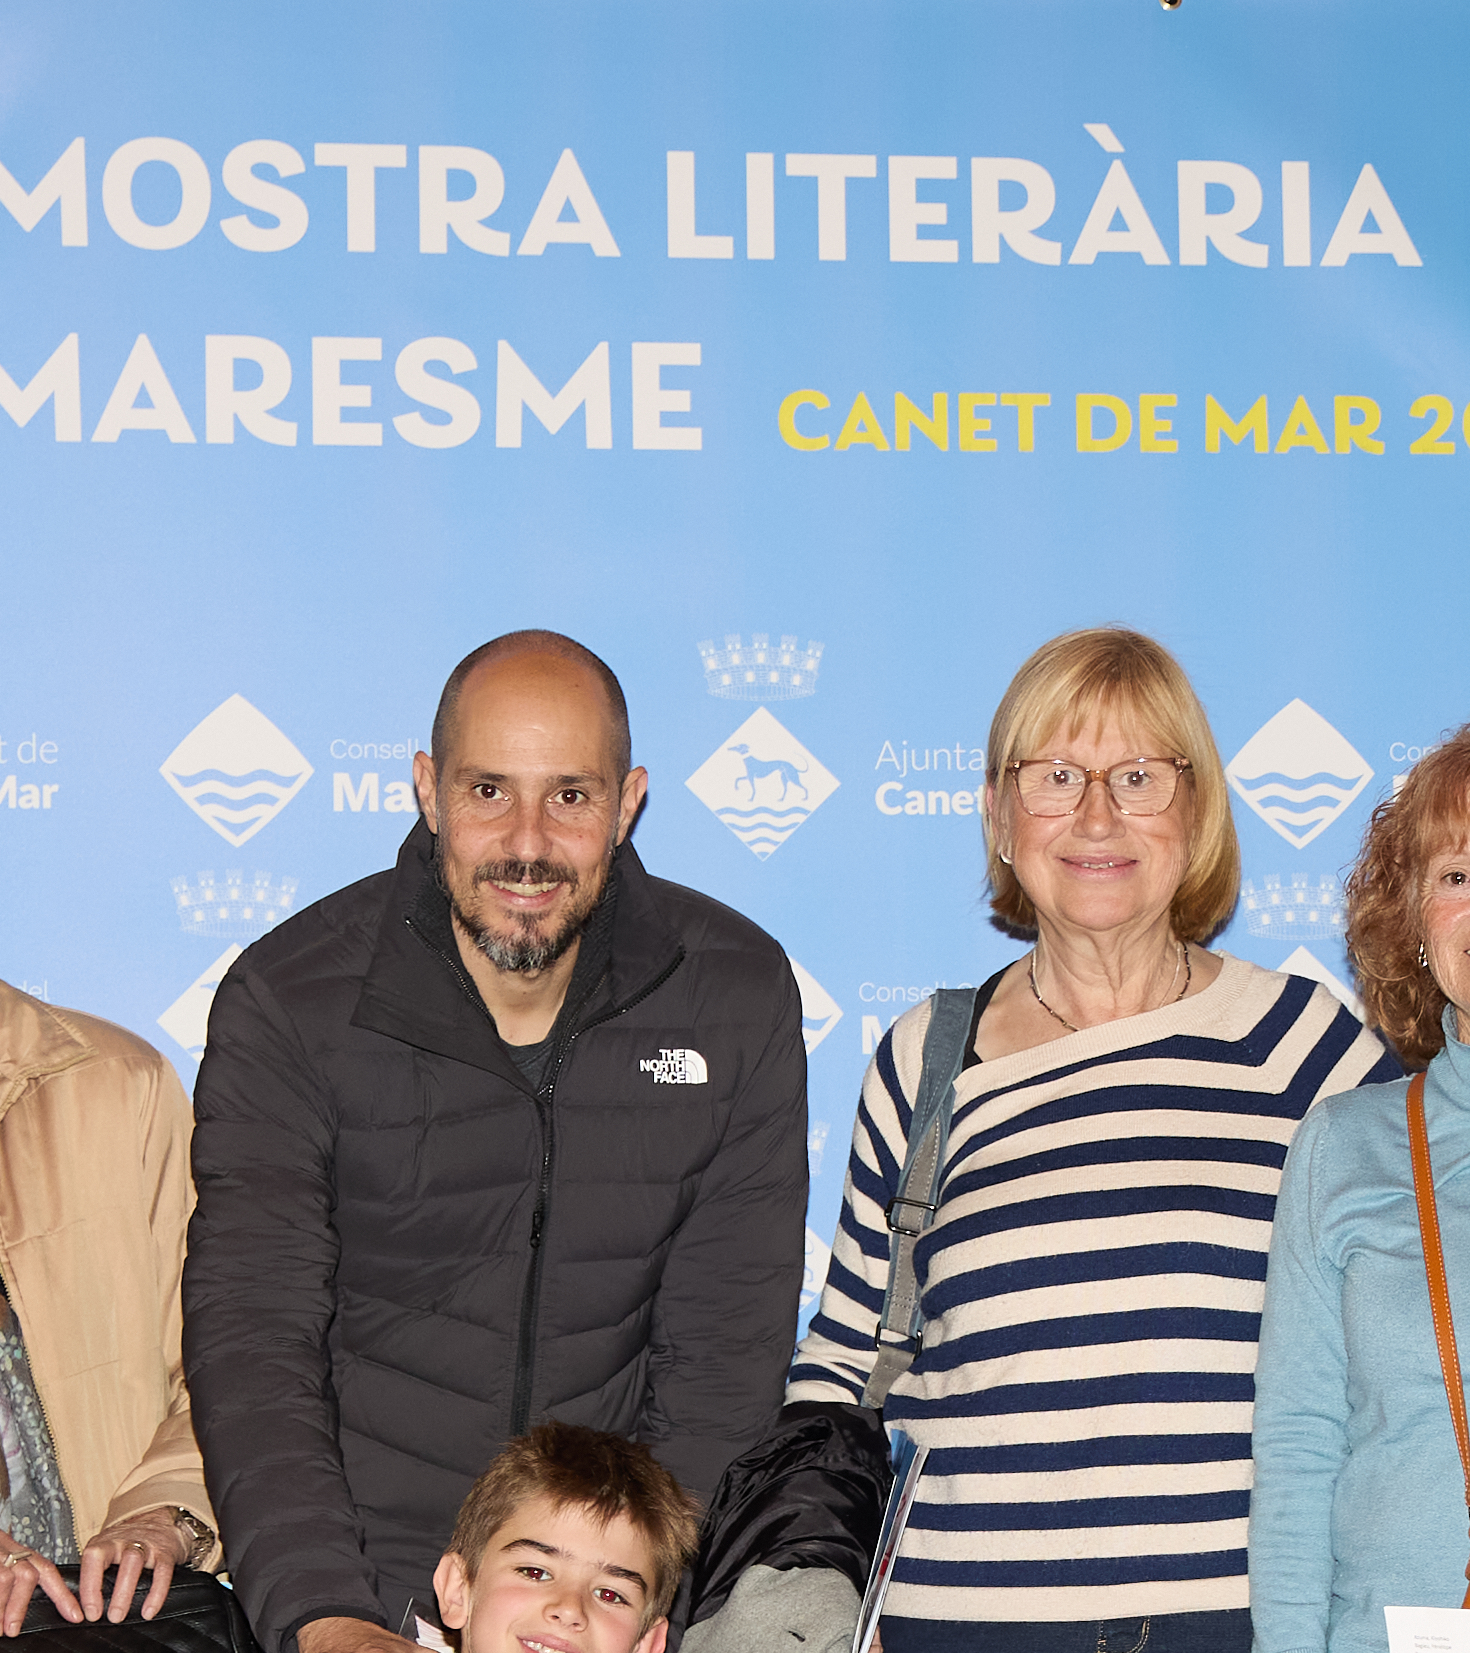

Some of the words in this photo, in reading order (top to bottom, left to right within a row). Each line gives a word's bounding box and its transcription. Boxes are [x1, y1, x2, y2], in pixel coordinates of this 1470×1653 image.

[667, 123, 1423, 269] LITERÀRIA
[777, 390, 1051, 453] CANET
[1074, 394, 1179, 453] DE
[1204, 394, 1385, 456] MAR
[329, 738, 420, 761] Consell
[658, 1048, 685, 1061] THE
[639, 1060, 685, 1072] NORTH
[653, 1072, 686, 1085] FACE
